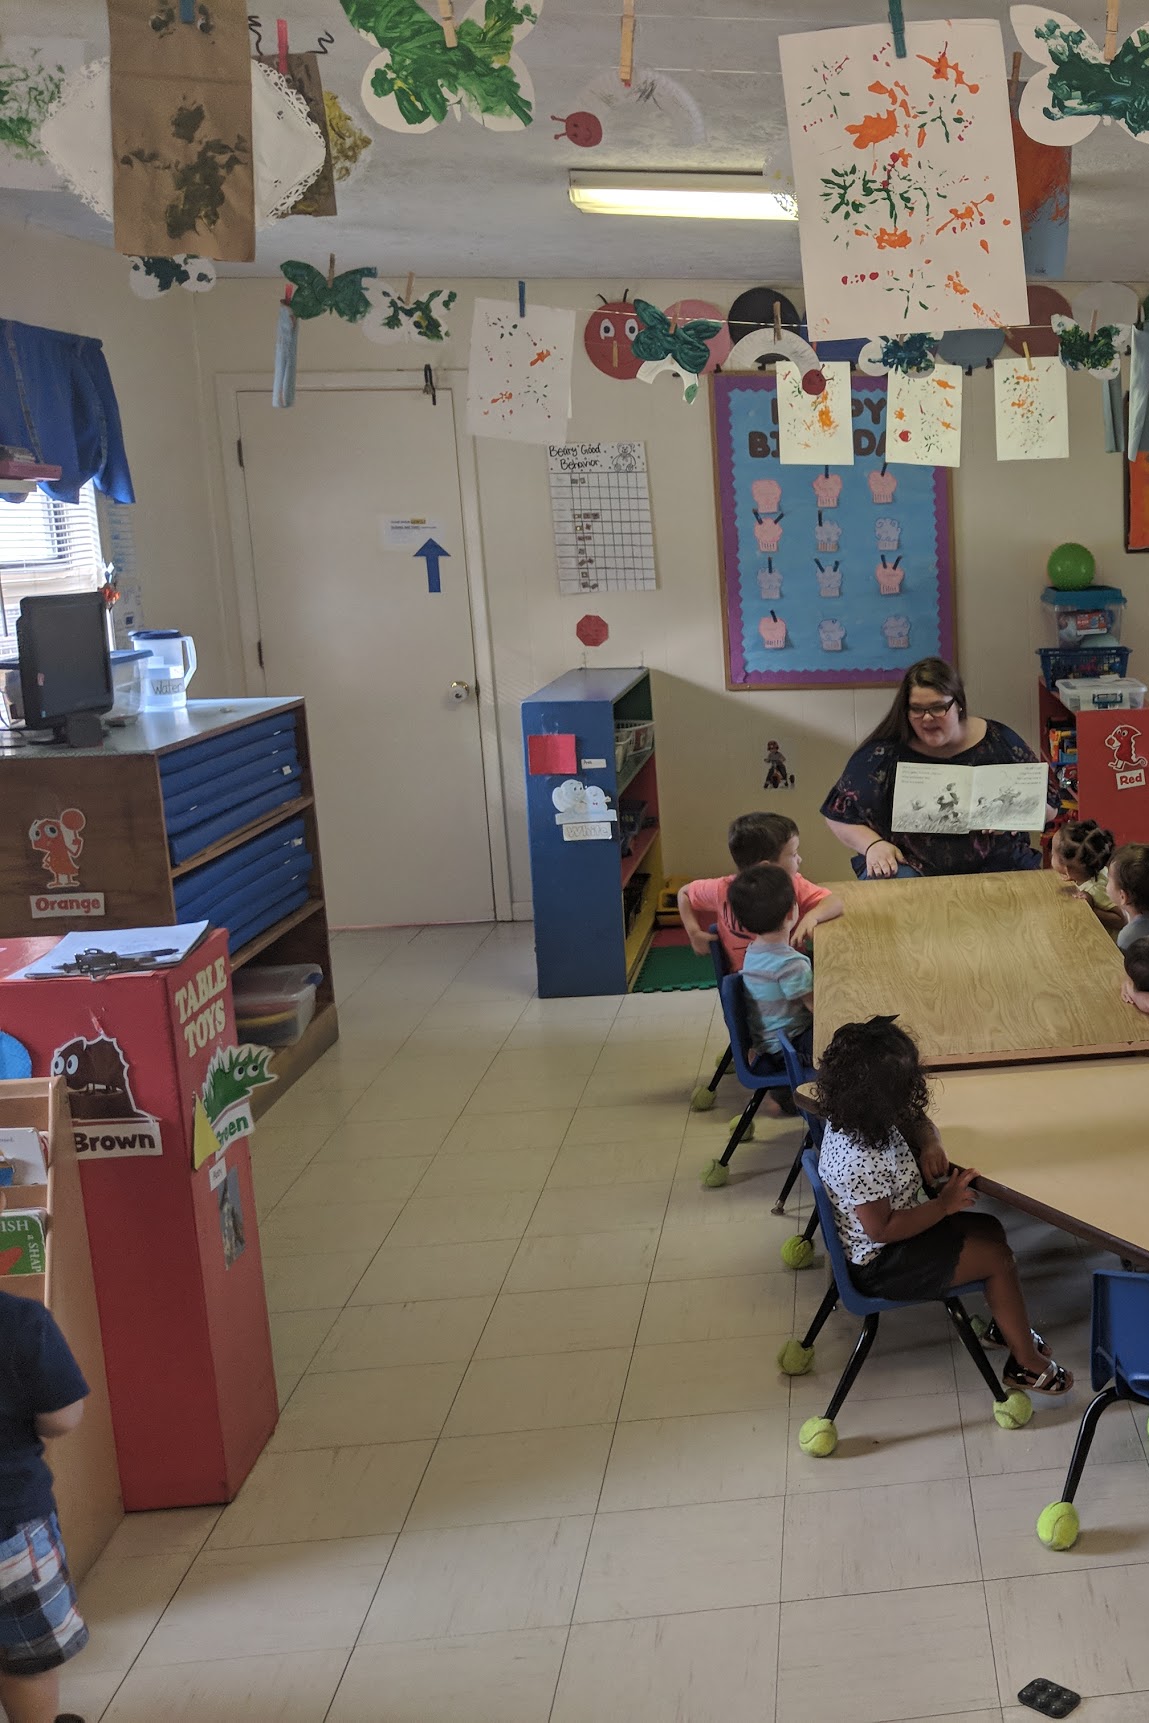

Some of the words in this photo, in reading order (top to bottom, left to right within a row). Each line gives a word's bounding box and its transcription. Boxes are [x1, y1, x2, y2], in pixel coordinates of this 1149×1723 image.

[581, 443, 602, 455] Good
[560, 459, 600, 470] Behavior
[151, 680, 183, 695] Water
[1120, 773, 1143, 785] Red
[566, 826, 609, 838] White
[35, 897, 101, 913] Orange
[175, 956, 228, 1024] TABLE
[184, 998, 226, 1058] TOYS
[74, 1132, 156, 1153] Brown
